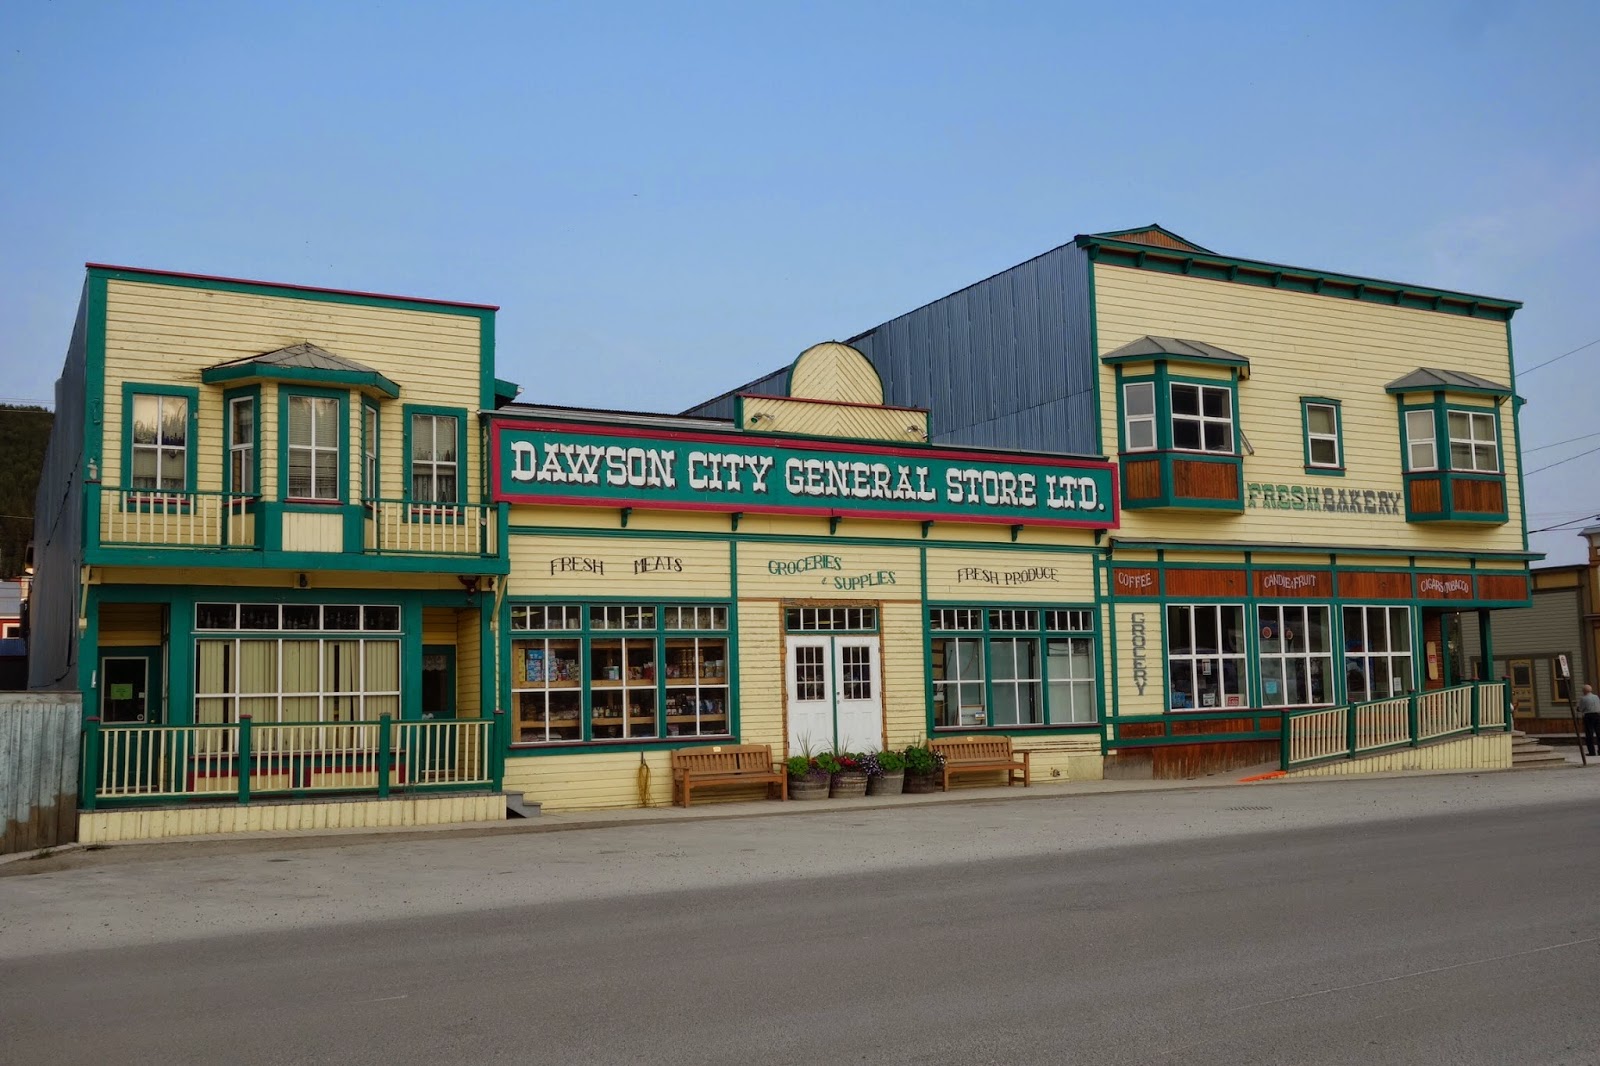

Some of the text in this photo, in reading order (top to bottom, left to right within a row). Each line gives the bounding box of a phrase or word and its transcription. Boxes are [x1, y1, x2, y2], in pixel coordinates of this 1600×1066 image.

[510, 440, 1106, 512] DAWSON CITY GENERAL STORE LTD.
[1247, 482, 1401, 516] FRESH BAKERY
[550, 555, 684, 576] FRESH MEATS
[768, 554, 842, 576] GROCERIES
[833, 570, 897, 590] SUPPLIES
[957, 566, 1060, 586] FRESH PRODUCE
[1118, 572, 1153, 589] COFFEE
[1130, 611, 1150, 697] GROCERY
